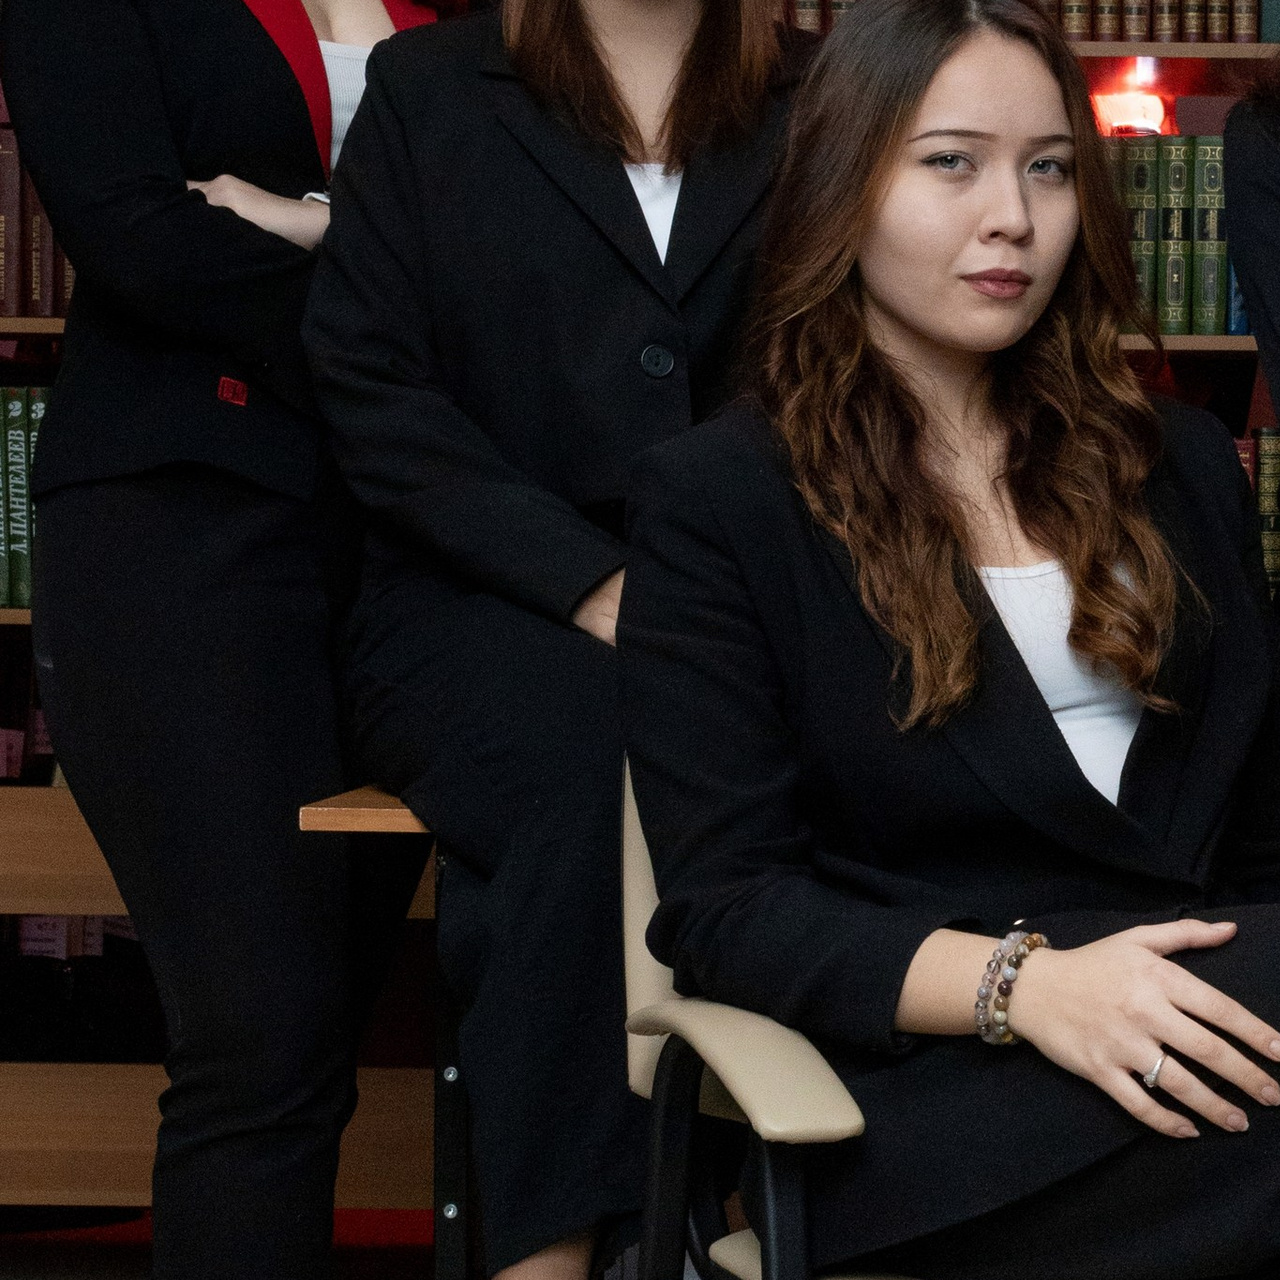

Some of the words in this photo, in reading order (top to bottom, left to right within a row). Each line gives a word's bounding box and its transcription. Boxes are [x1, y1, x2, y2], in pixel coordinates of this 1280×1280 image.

[32, 215, 41, 249] КАТАЕВ
[32, 252, 41, 300] ВАЛЕНТИН
[8, 400, 22, 418] 2
[8, 430, 28, 537] ПАНТЕЛЕЕВ
